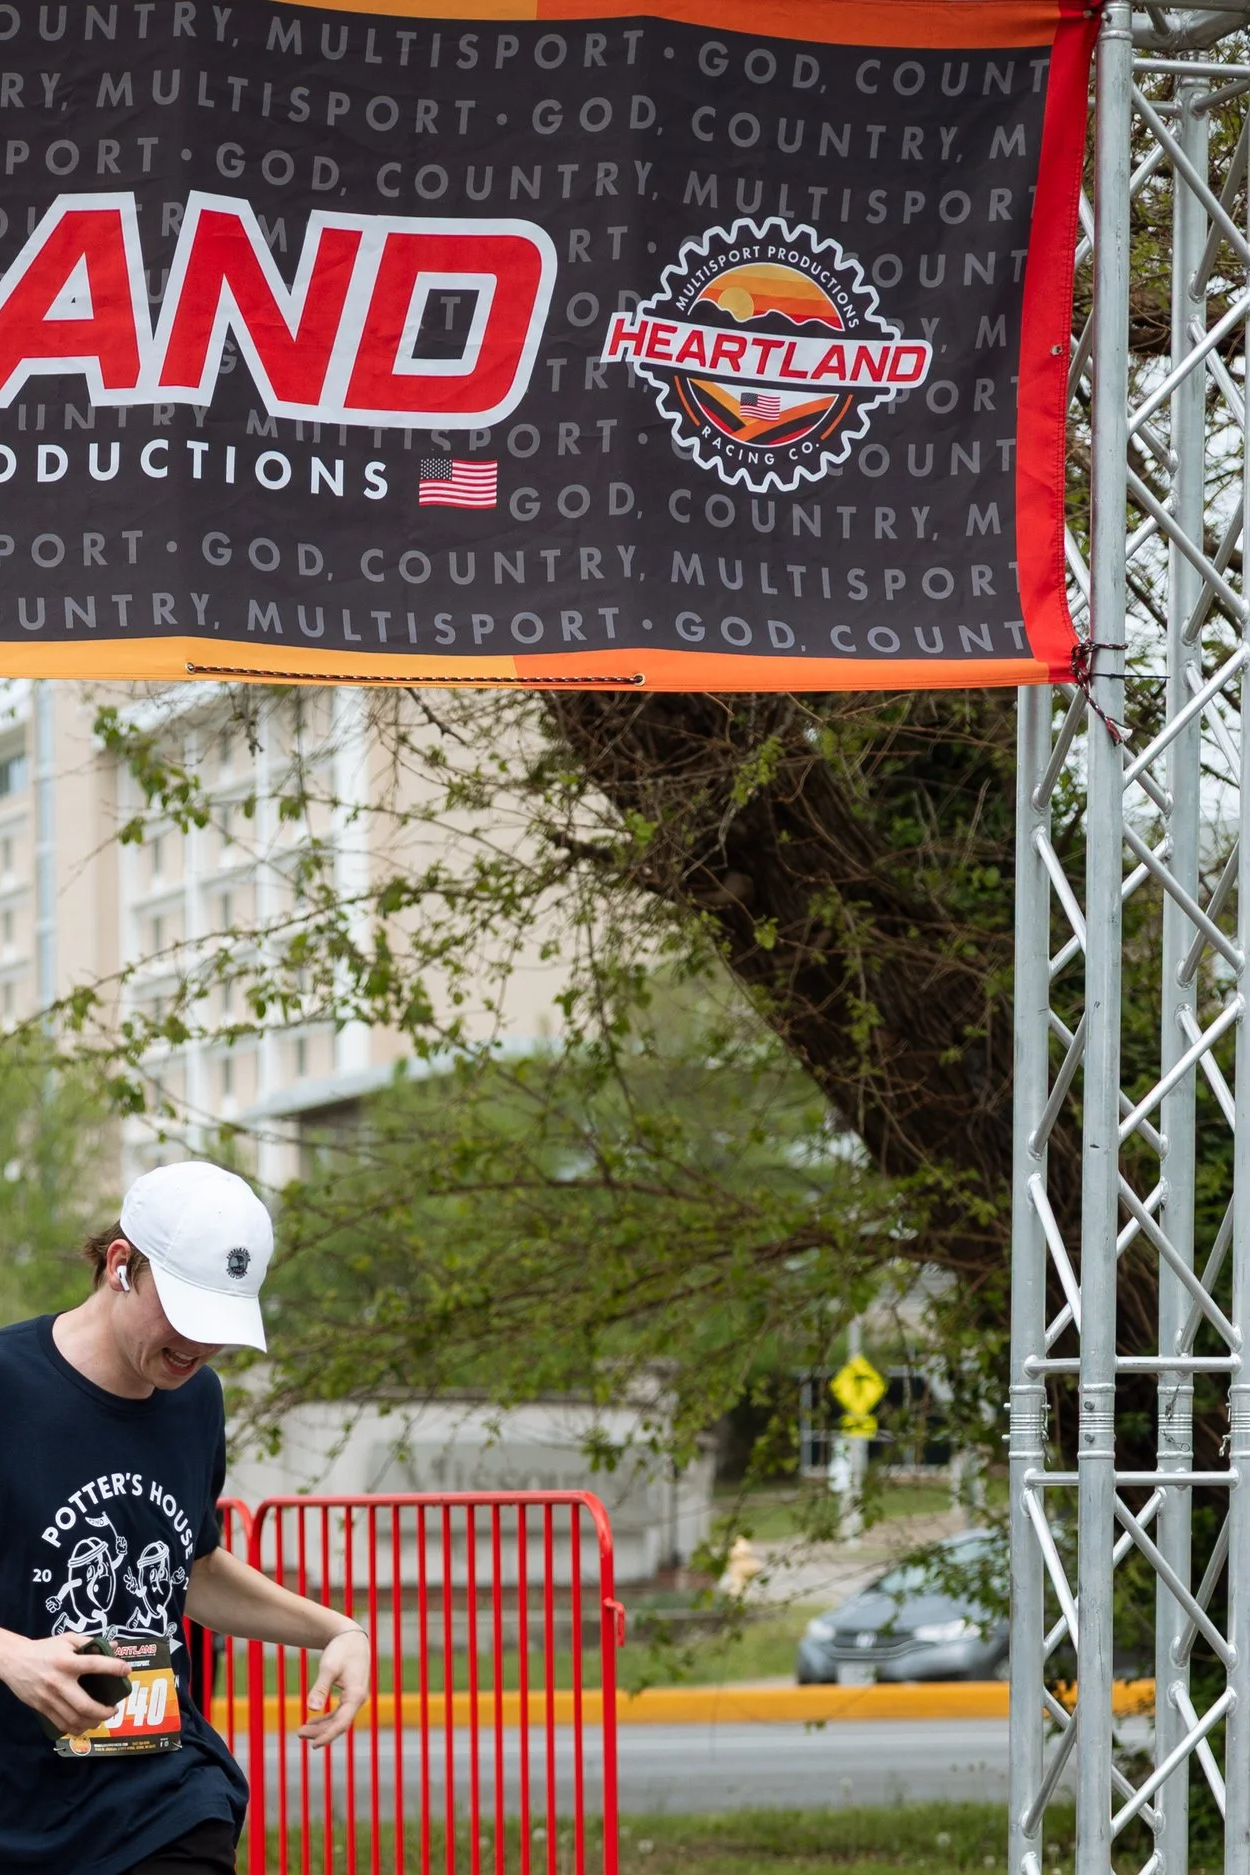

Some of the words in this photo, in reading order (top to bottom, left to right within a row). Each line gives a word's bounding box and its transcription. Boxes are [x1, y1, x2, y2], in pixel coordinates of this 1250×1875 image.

[265, 15, 645, 70] MULTISPORT
[697, 40, 827, 94] GOD,
[96, 69, 476, 134] MULTISPORT
[531, 95, 663, 137] GOD,
[691, 105, 963, 163] COUNTRY,
[215, 141, 347, 197] GOD,
[376, 160, 658, 200] COUNTRY,
[675, 246, 760, 312] MULTISPORT
[768, 246, 859, 329] PRODUCTIONS
[605, 317, 928, 385] HEARTLAND
[701, 425, 775, 465] RACING
[789, 441, 820, 461] CO.
[826, 438, 1016, 477] OUNT
[508, 482, 643, 522] GOD,
[668, 488, 938, 541] COUNTRY,
[201, 531, 333, 581] GOD,
[359, 545, 645, 585] COUNTRY,
[246, 600, 619, 645] MULTISPORT
[41, 1472, 144, 1548] POTTER'S
[150, 1481, 195, 1560] HOUSE
[32, 1568, 52, 1583] 20
